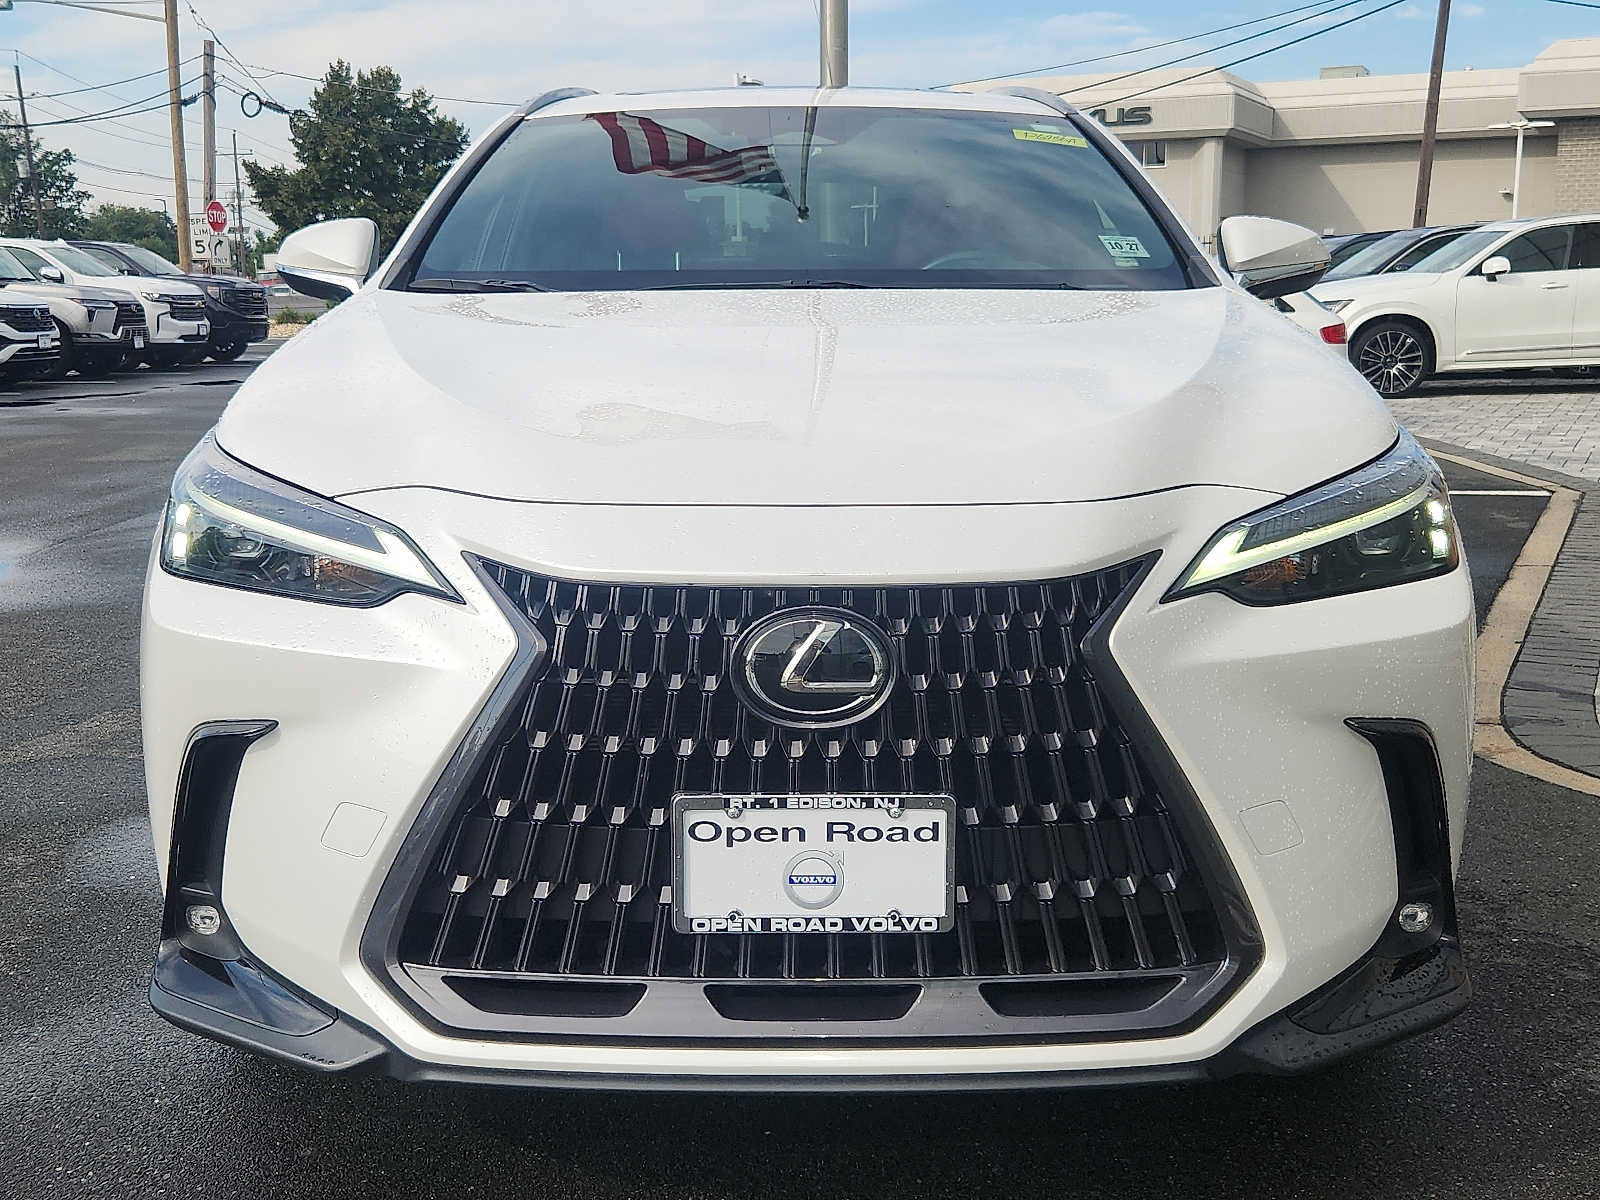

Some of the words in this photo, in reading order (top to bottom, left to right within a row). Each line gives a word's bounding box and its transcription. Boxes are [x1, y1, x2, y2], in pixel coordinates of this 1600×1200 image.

[1089, 106, 1152, 127] US
[208, 211, 225, 223] STOP
[1108, 241, 1123, 250] 10
[1126, 242, 1139, 251] 27
[729, 797, 761, 809] RT.
[769, 797, 778, 809] 1
[873, 797, 900, 809] NJ
[687, 820, 806, 848] Open
[826, 821, 940, 843] Road
[692, 917, 762, 932] OPEN
[770, 917, 843, 932] ROAD
[850, 917, 938, 932] VOLVO
